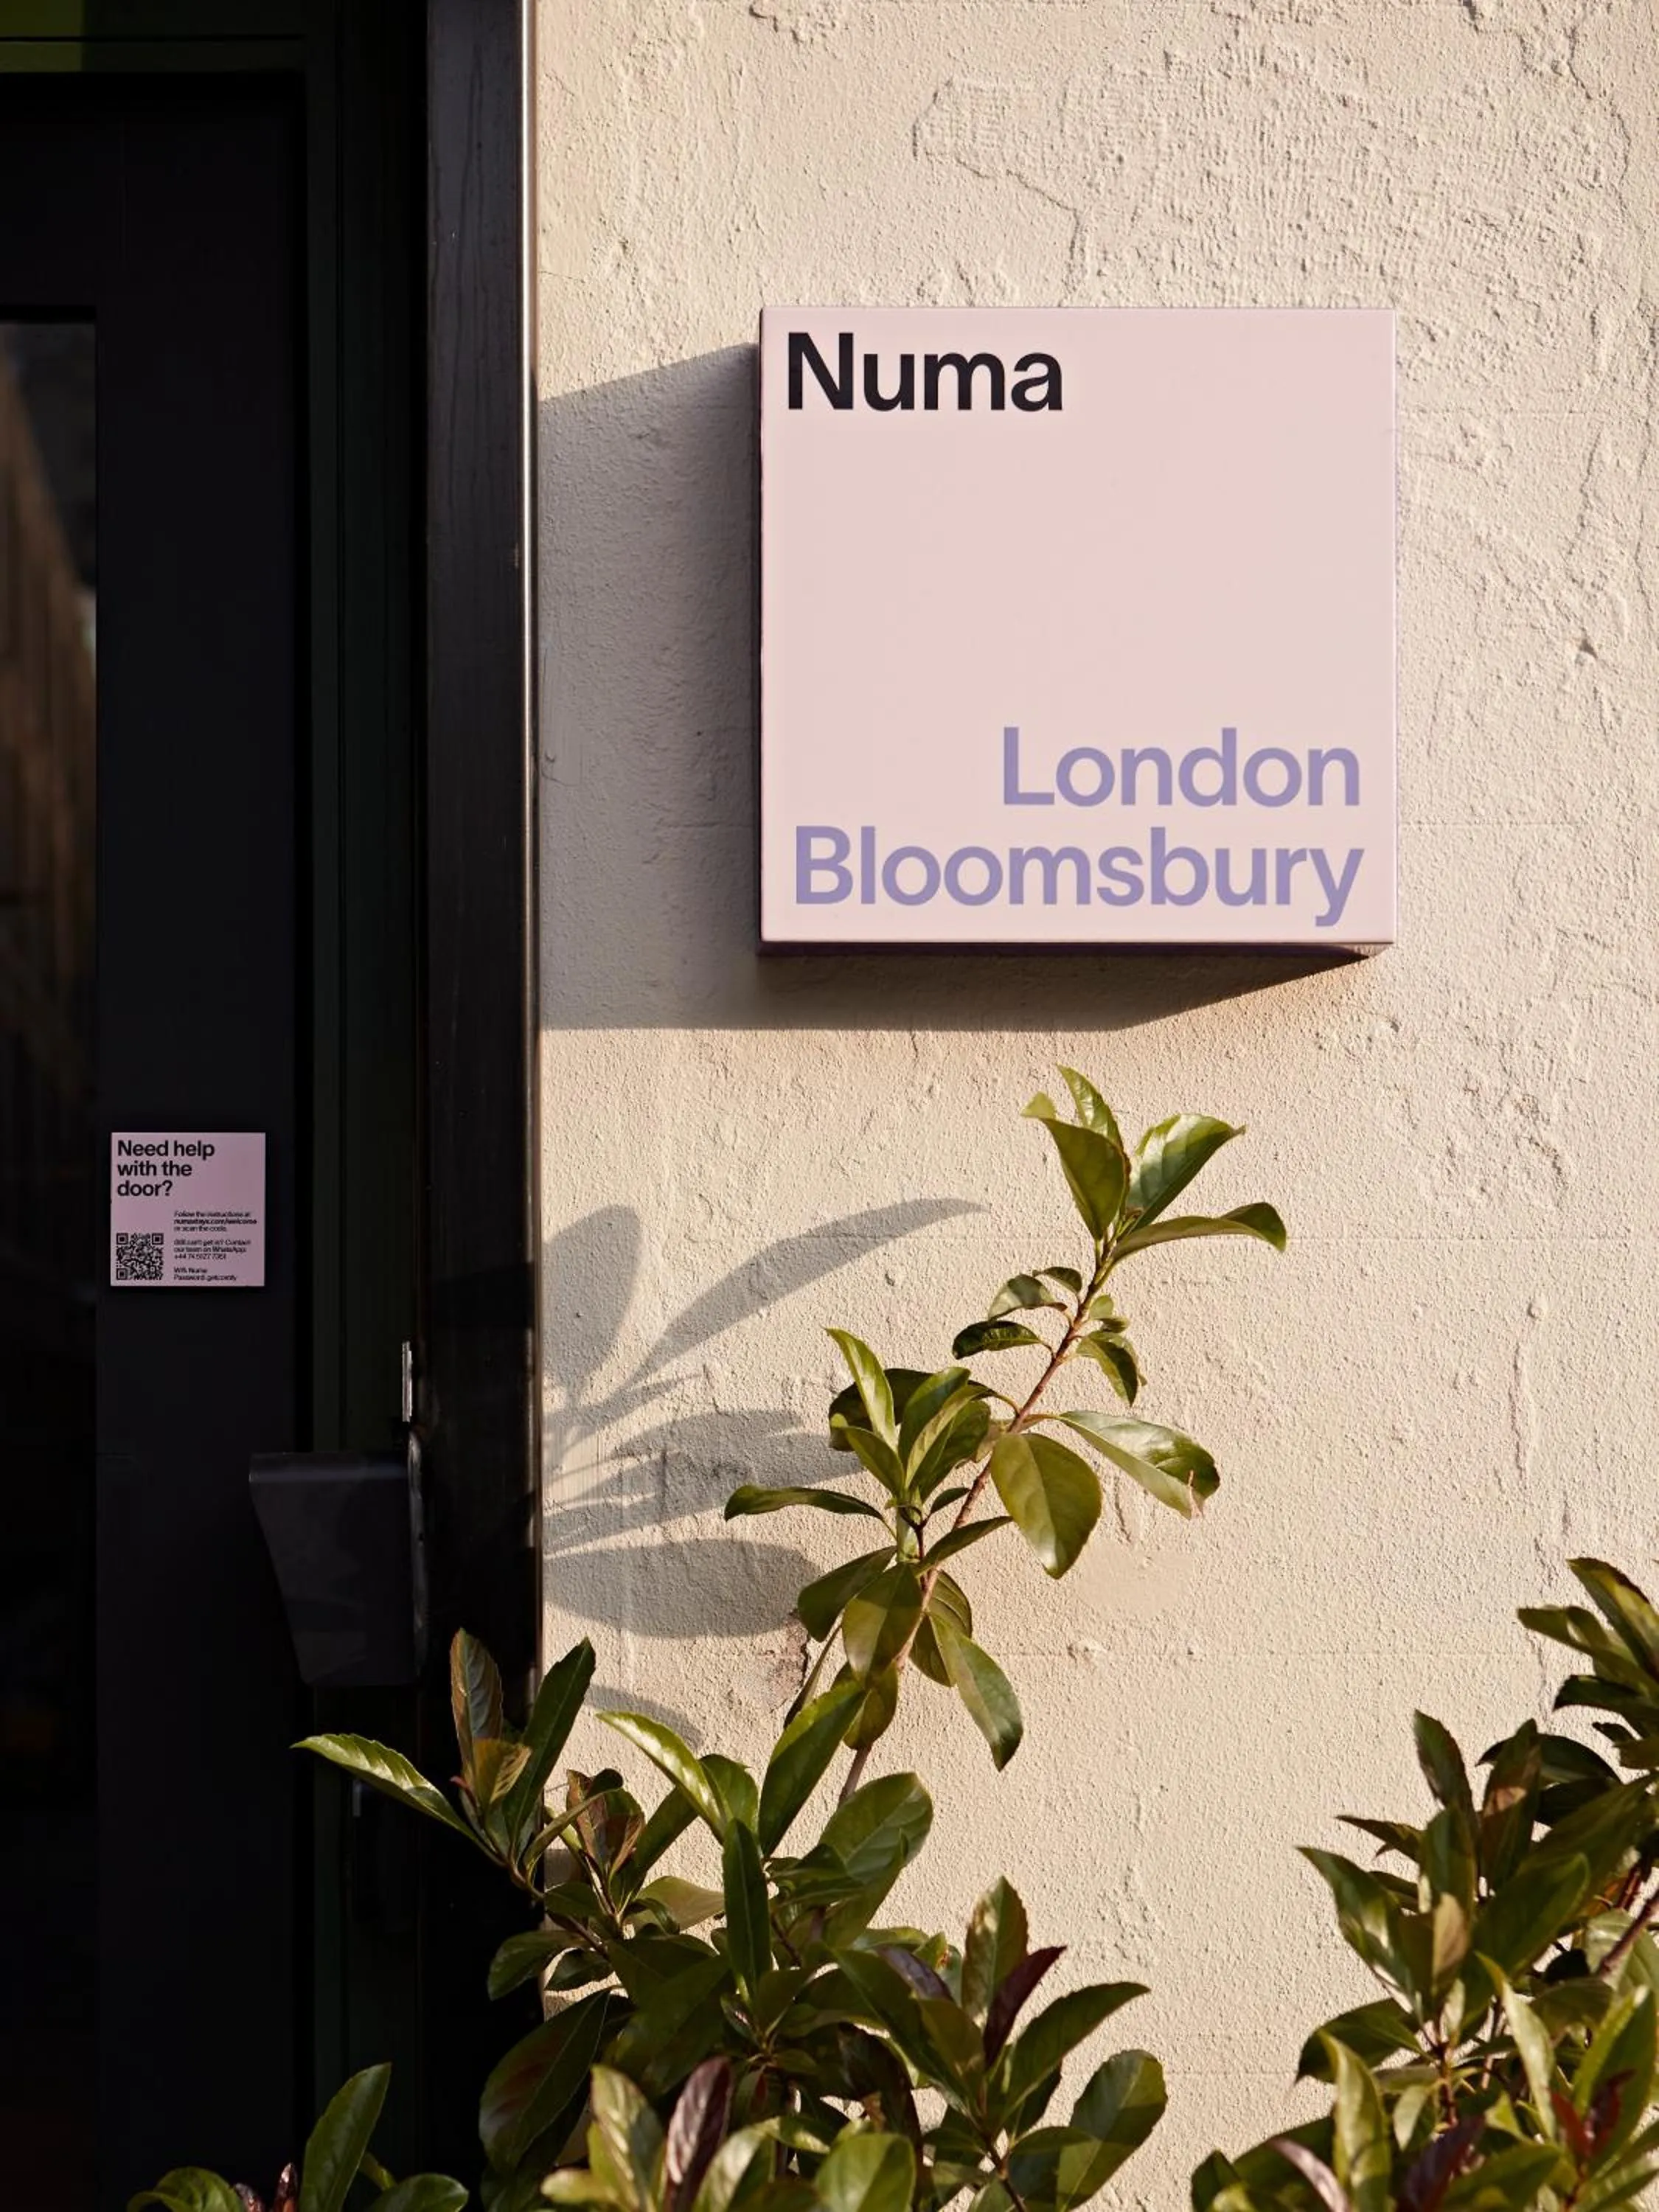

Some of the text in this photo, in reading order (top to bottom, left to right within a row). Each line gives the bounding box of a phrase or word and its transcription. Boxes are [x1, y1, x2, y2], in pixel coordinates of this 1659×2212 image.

[787, 332, 1063, 412] Numa
[1004, 727, 1361, 807] London
[795, 826, 1365, 928] Bloomsbury
[117, 1161, 192, 1176] with the
[118, 1140, 215, 1161] Need help
[117, 1180, 173, 1196] door?
